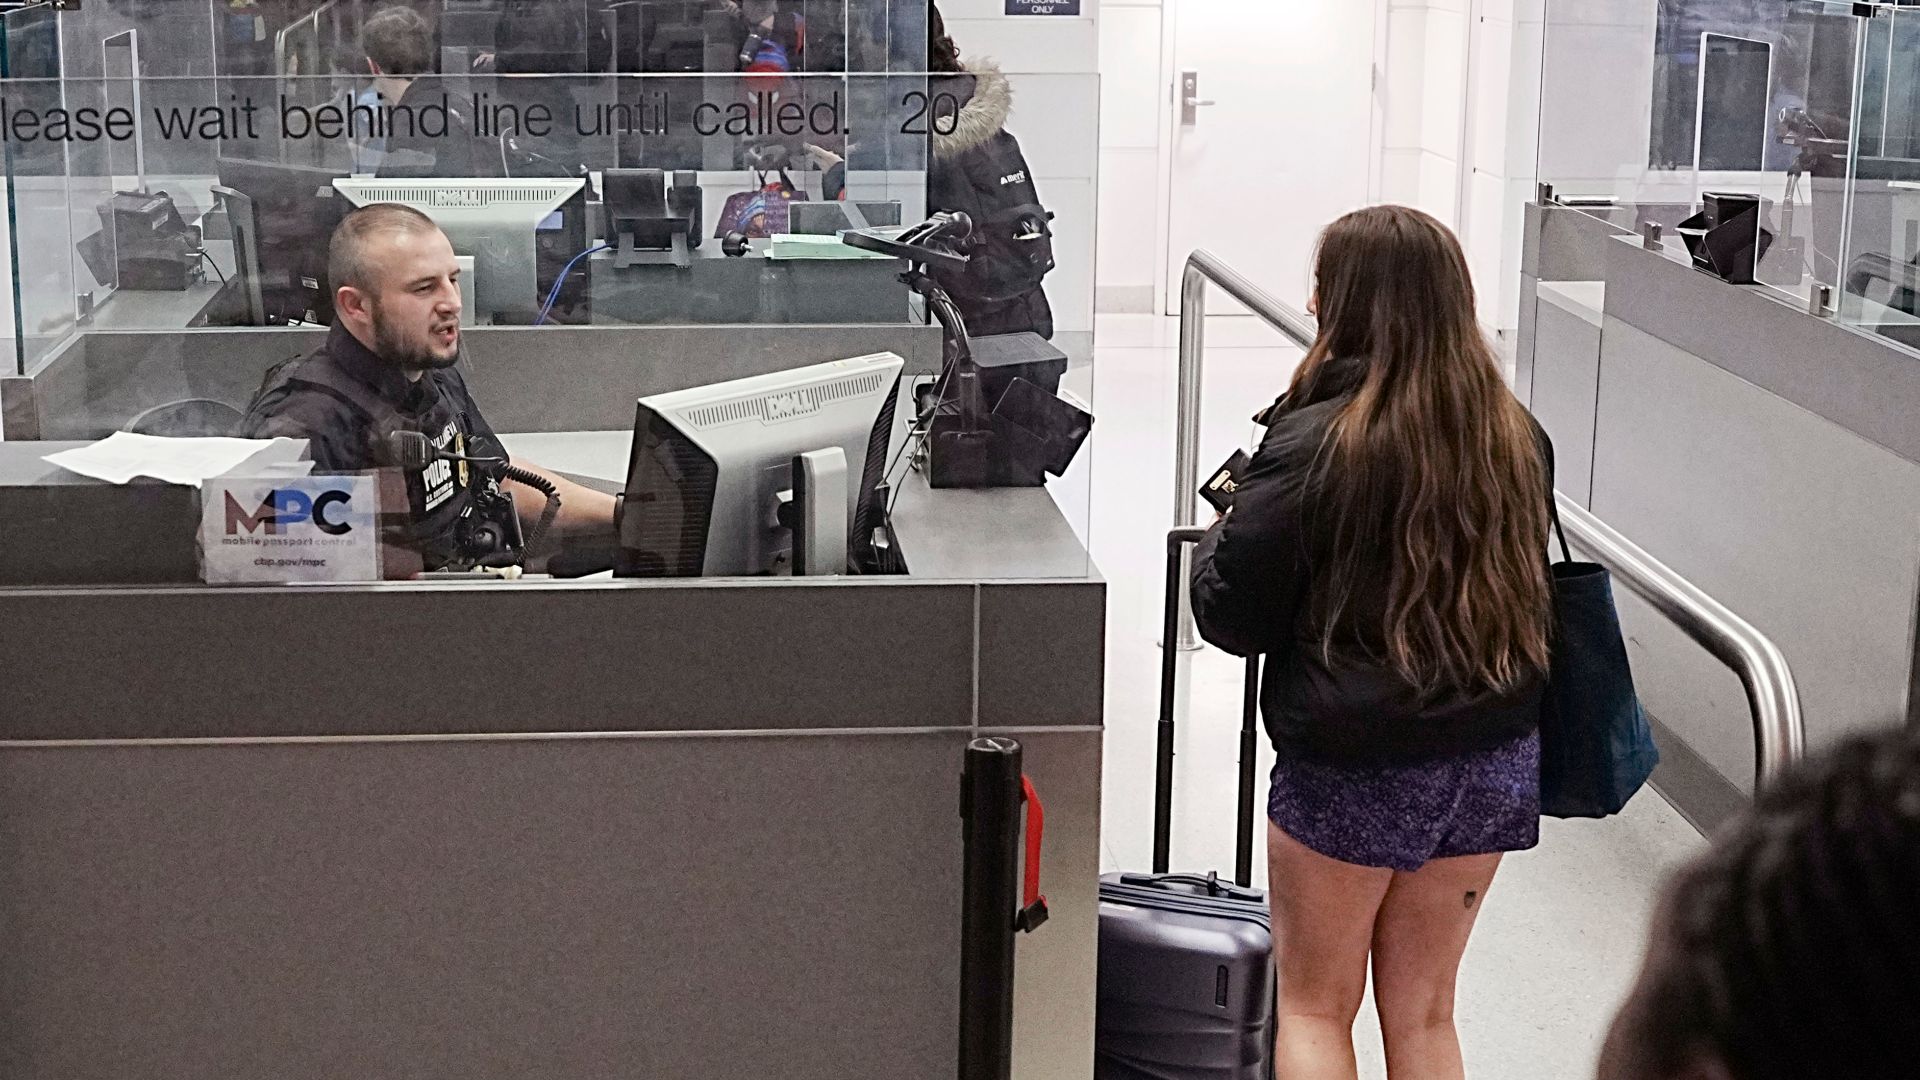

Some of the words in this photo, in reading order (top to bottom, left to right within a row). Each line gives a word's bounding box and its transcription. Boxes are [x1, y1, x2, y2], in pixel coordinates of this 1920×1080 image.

[1031, 5, 1054, 13] ONLY
[1, 97, 134, 141] lease
[154, 94, 258, 140] wait
[281, 93, 448, 139] behind
[473, 92, 552, 138] line
[575, 91, 670, 137] until
[692, 91, 850, 136] called.
[900, 91, 959, 136] 20
[224, 489, 353, 535] MPC
[253, 557, 327, 568] cbp.gov/mpc
